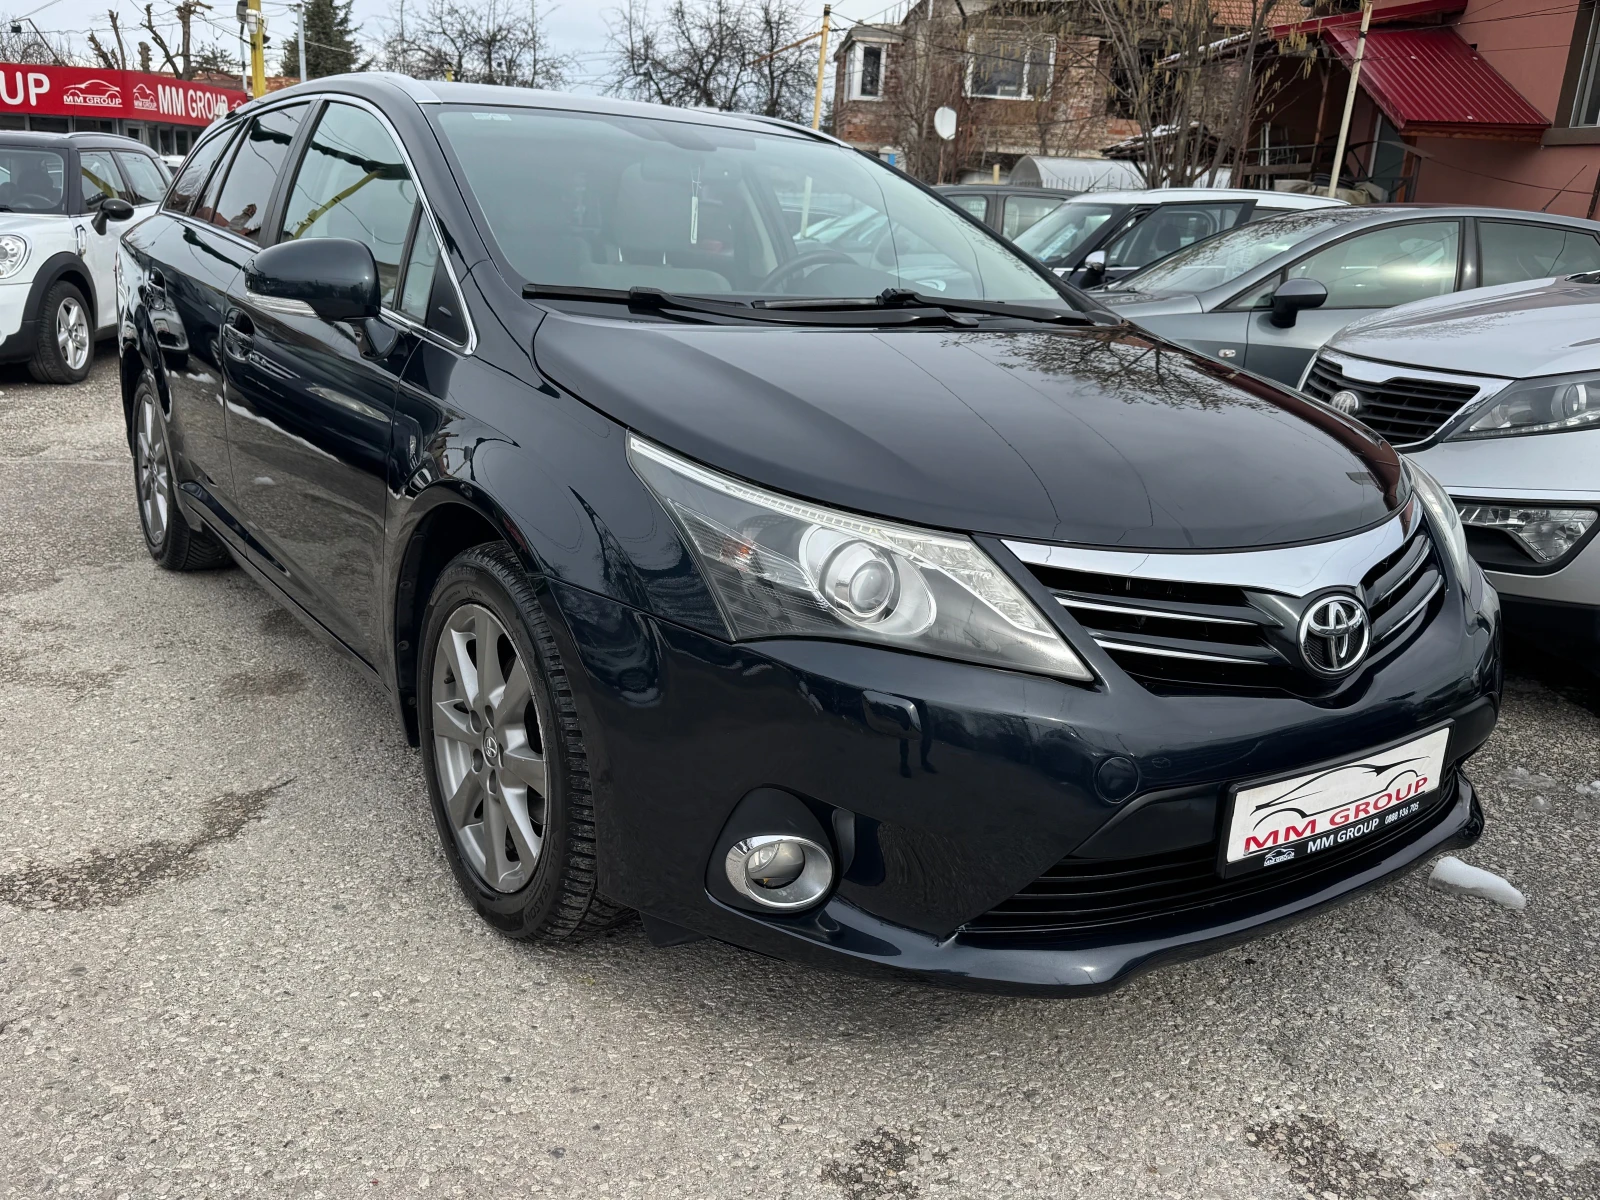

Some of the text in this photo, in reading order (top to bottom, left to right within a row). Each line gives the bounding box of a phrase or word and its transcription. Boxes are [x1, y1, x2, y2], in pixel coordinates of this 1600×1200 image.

[0, 70, 50, 106] UP
[63, 95, 122, 105] MM GROUP
[158, 84, 185, 116] MM
[1244, 777, 1428, 852] MM GROUP
[1307, 835, 1334, 853] MM
[1337, 818, 1379, 843] GROUP
[524, 878, 551, 924] SEASON
